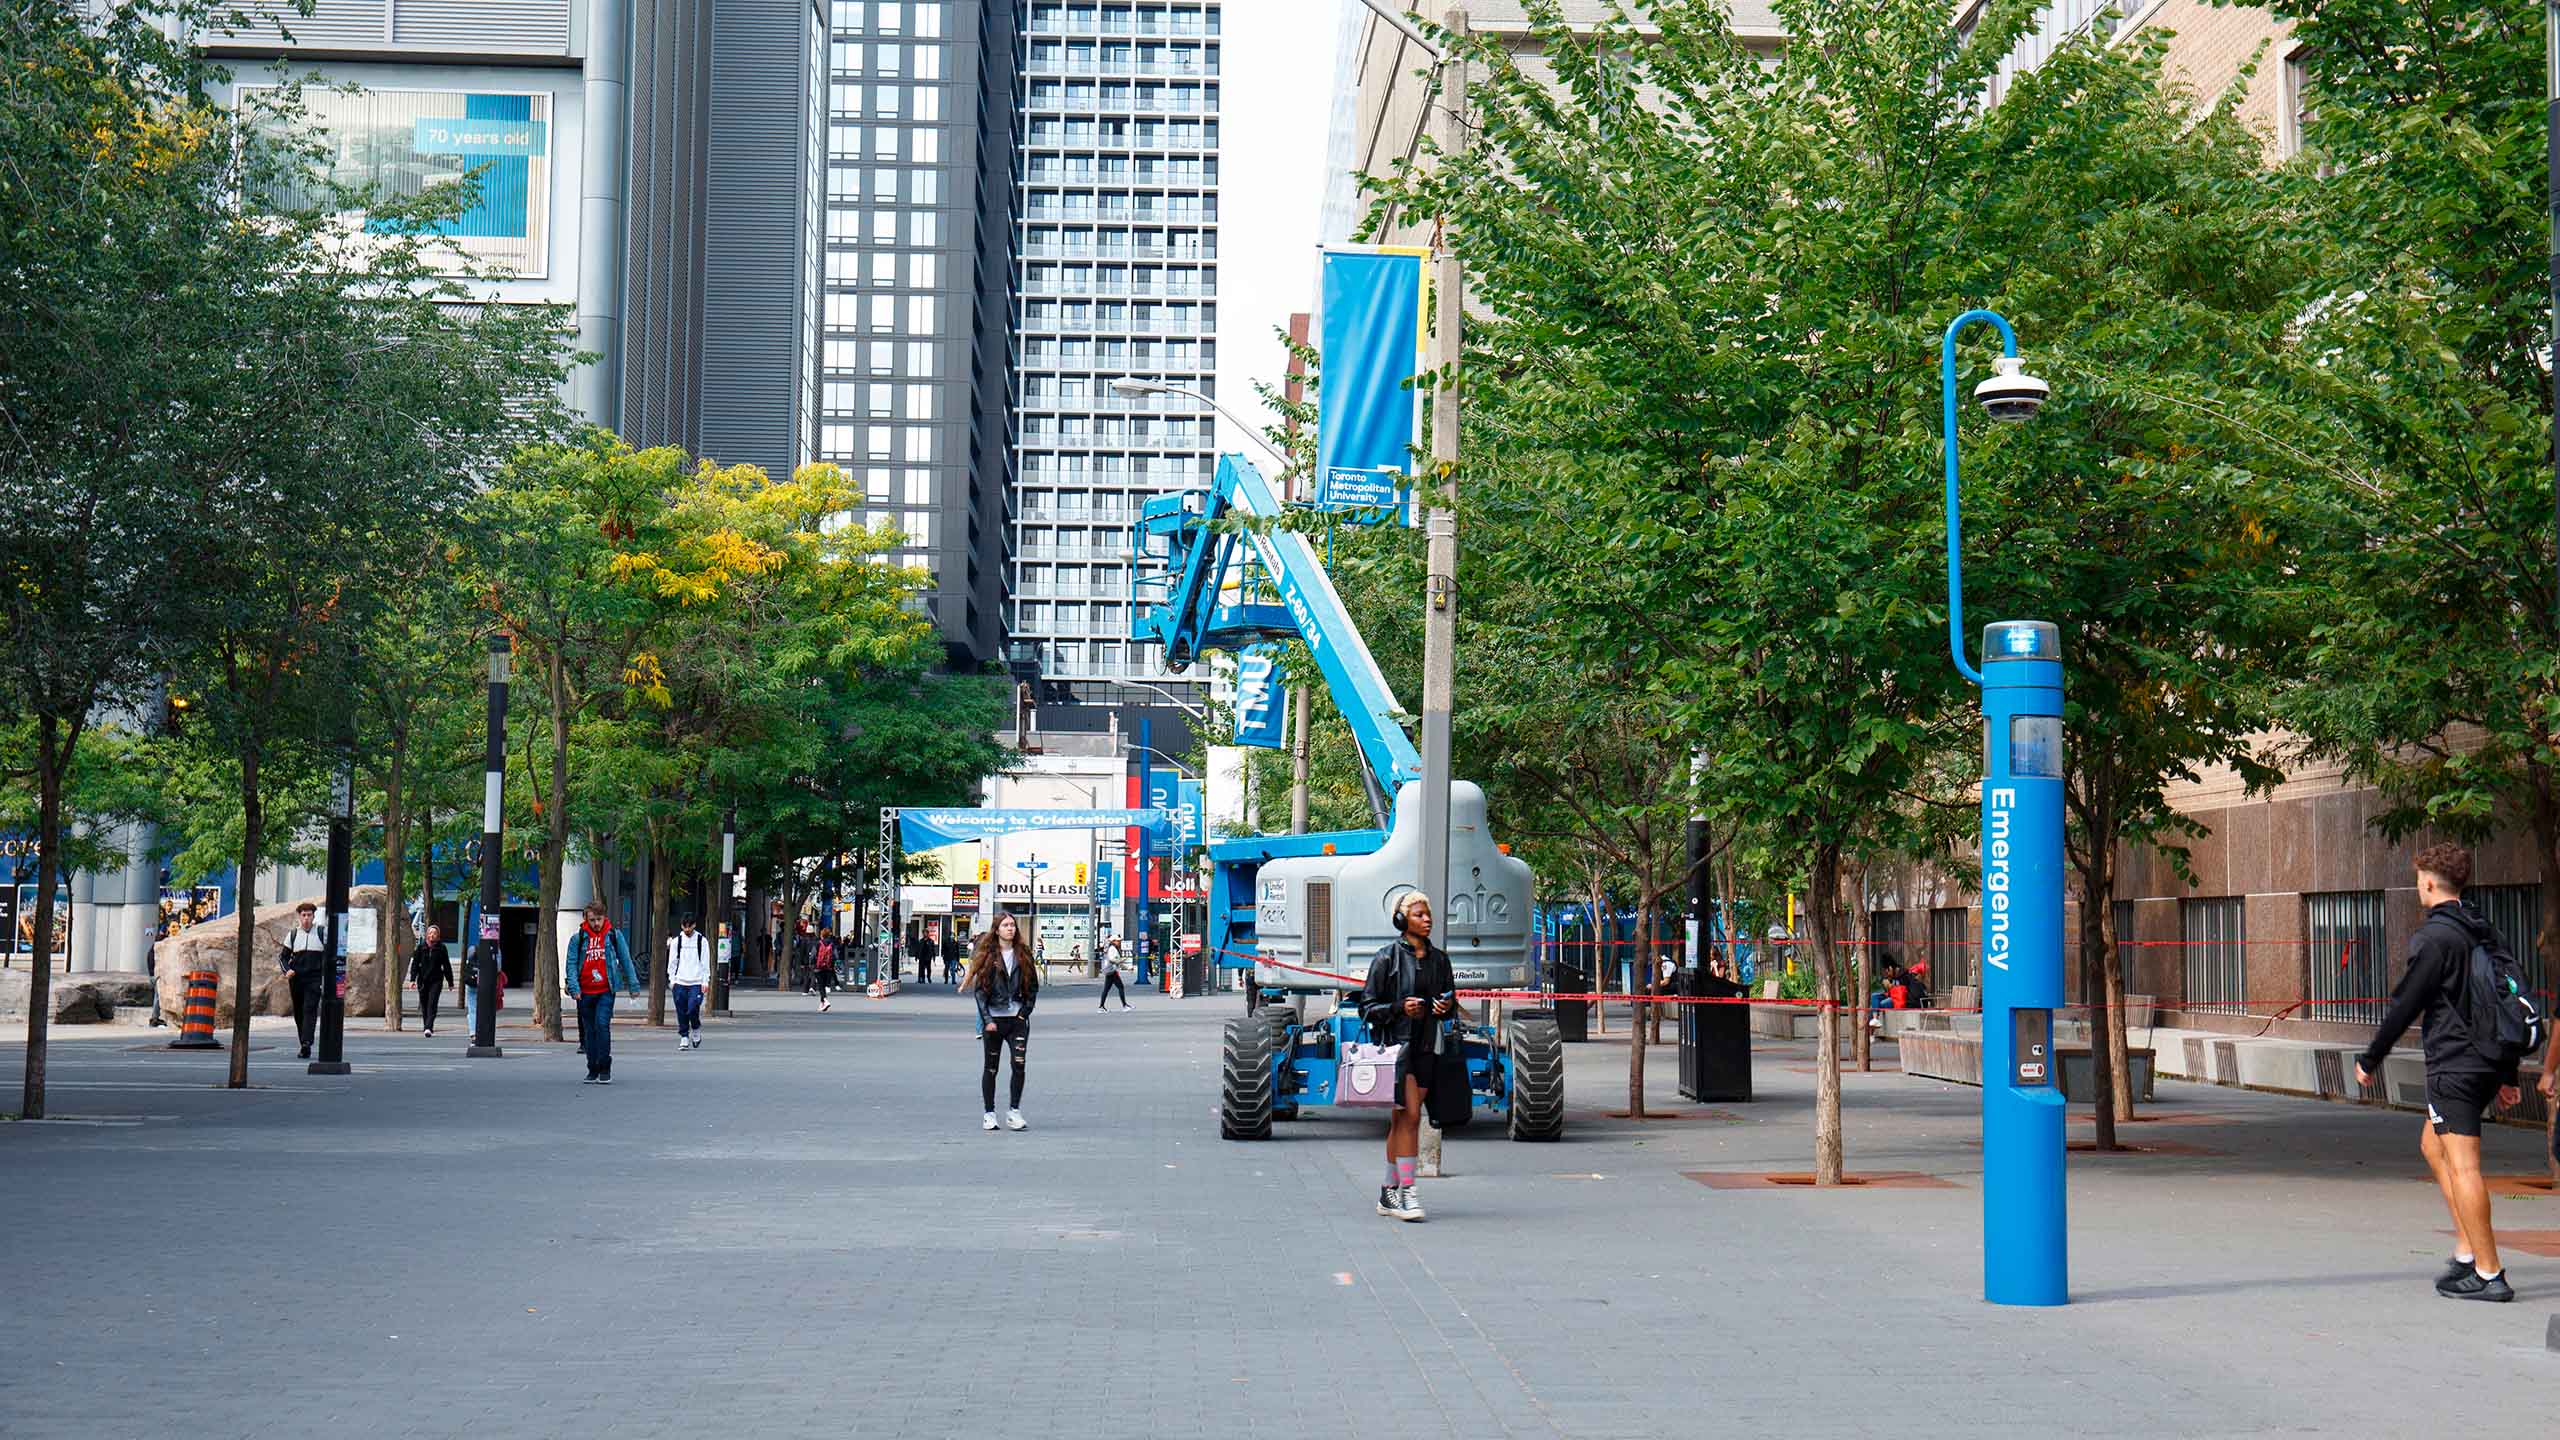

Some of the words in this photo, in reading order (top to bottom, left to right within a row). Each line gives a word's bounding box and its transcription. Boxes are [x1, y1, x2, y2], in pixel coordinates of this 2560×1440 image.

[428, 129, 448, 145] 70
[452, 131, 498, 147] years
[504, 131, 529, 145] old
[1331, 471, 1367, 482] Toronto
[1330, 481, 1391, 494] Metropolitan
[1329, 491, 1378, 504] University
[1239, 655, 1273, 736] TMU
[929, 814, 1005, 825] Welcome
[1009, 815, 1025, 825] to
[1182, 803, 1196, 842] TMU
[1987, 788, 2015, 971] Emergency
[997, 884, 1031, 894] NOW
[1097, 876, 1107, 903] TMU
